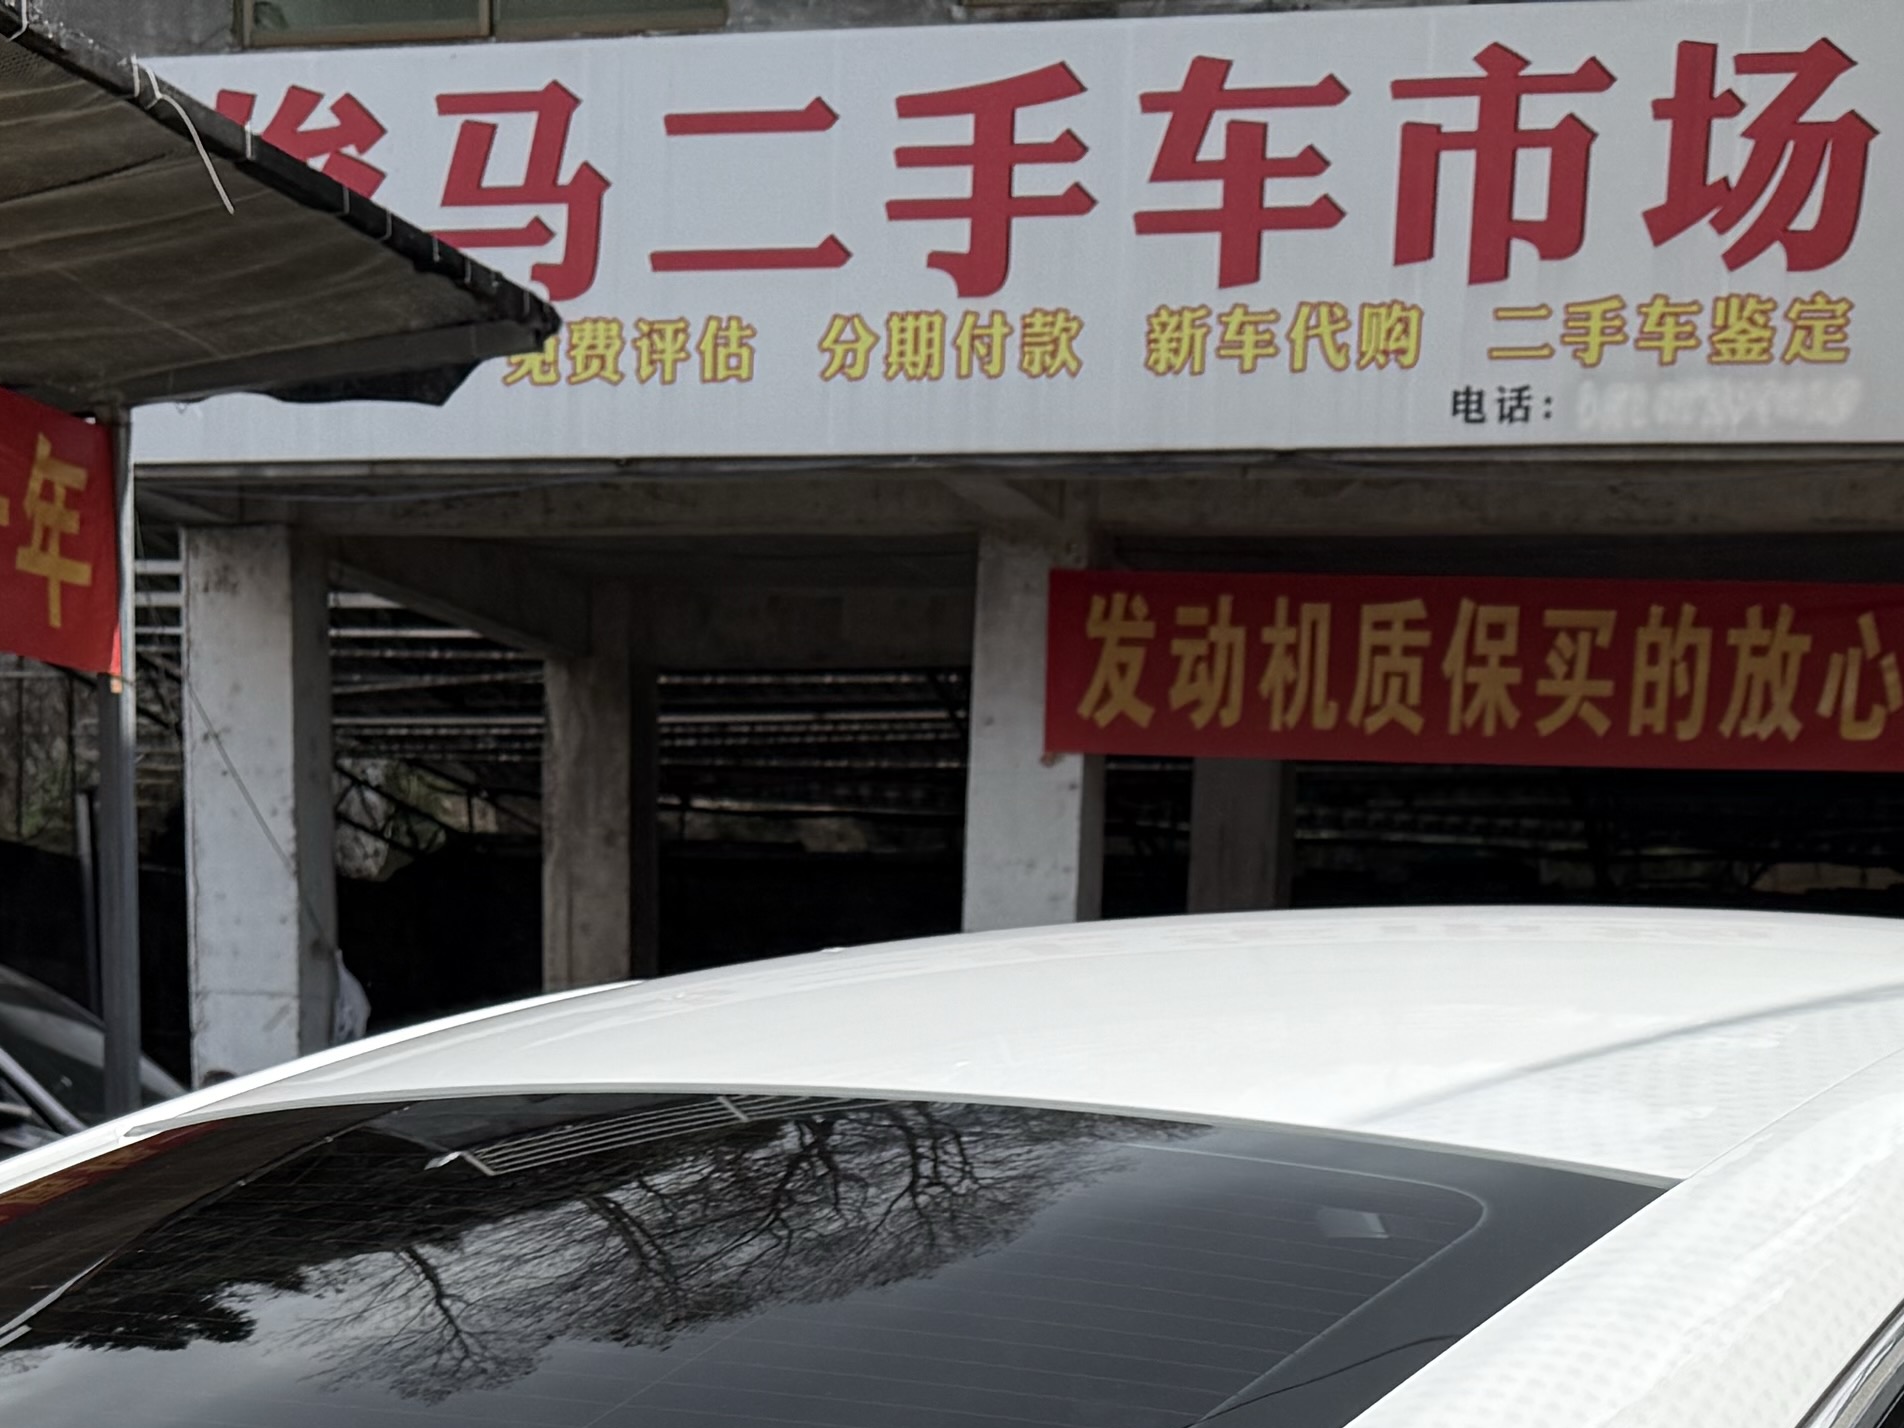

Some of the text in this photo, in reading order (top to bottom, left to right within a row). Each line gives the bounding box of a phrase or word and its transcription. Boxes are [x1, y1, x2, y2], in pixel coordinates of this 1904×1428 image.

[818, 308, 1082, 381] 分期付款
[1145, 300, 1423, 375] 新车代购
[1487, 293, 1855, 370] 二手车鉴定
[1450, 384, 1555, 425] 电话：
